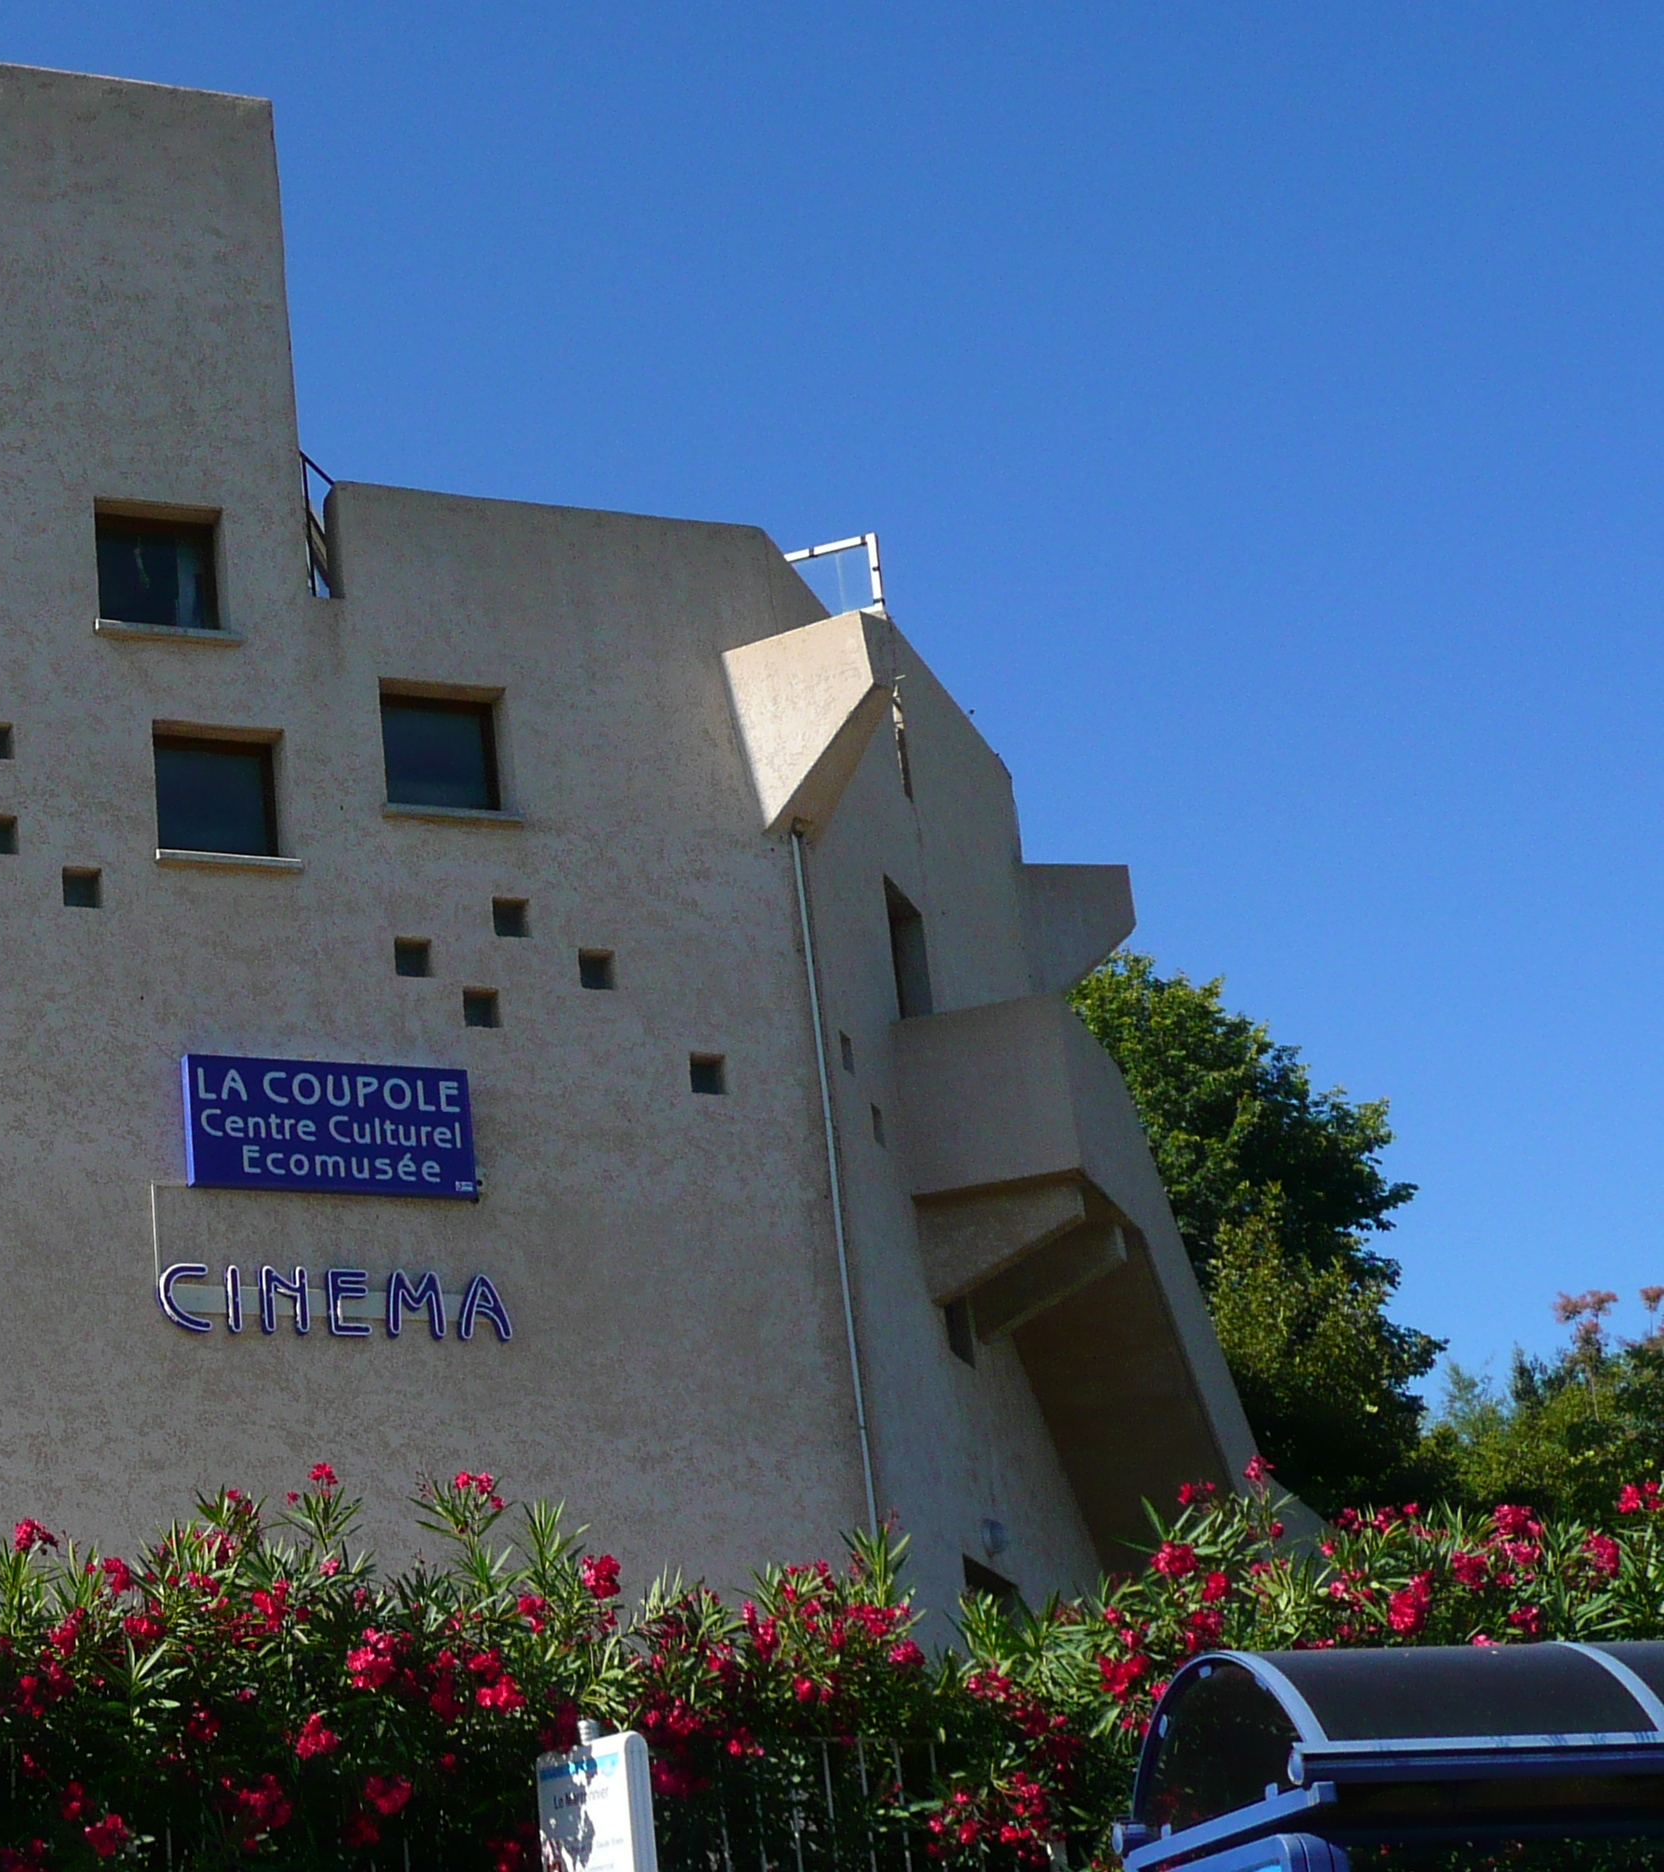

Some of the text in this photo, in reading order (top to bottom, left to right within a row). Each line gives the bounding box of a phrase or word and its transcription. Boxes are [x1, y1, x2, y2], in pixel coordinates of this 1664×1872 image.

[197, 1067, 461, 1113] LA COUPOLE
[200, 1108, 462, 1149] Centre Culturel
[242, 1145, 441, 1183] Ecomusée
[157, 1262, 513, 1341] CINEMA
